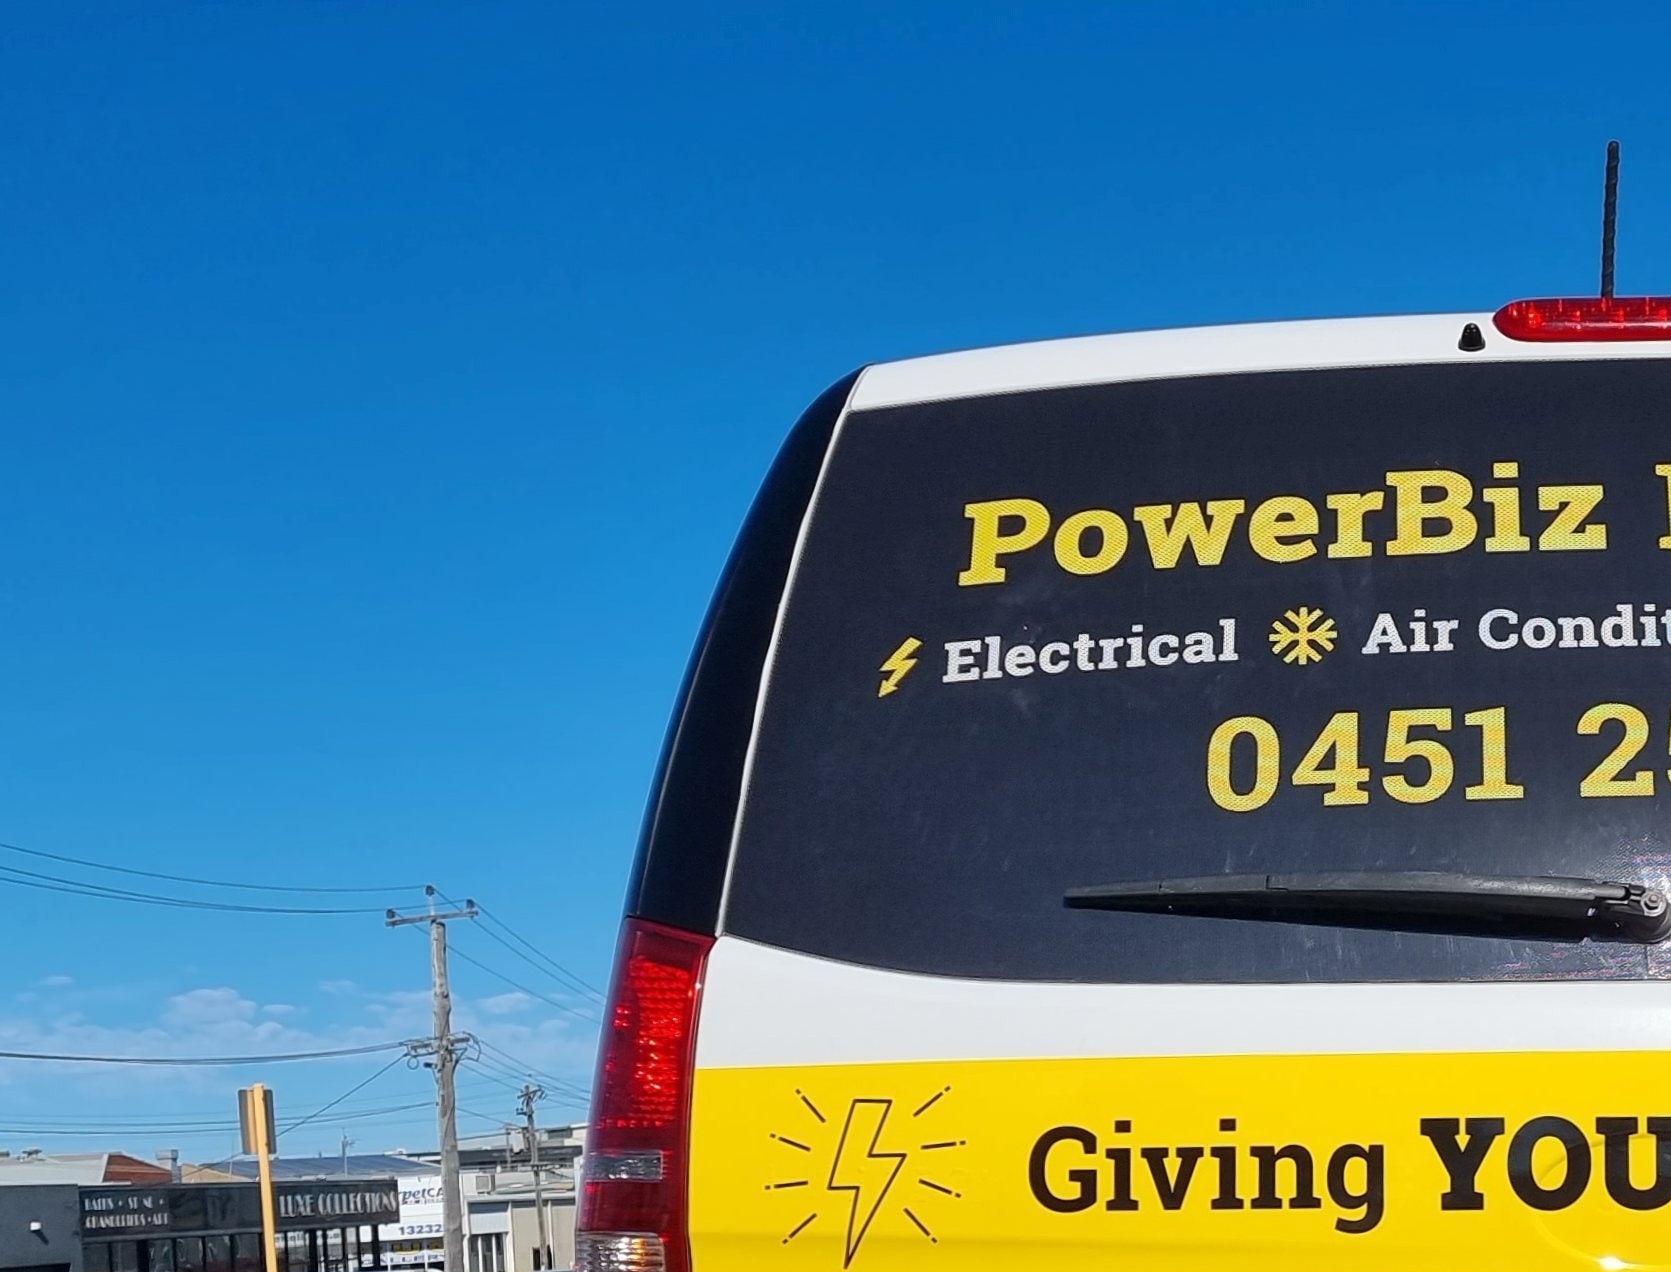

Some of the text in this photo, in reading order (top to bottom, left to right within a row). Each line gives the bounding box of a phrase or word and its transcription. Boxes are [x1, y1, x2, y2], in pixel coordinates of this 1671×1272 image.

[957, 461, 1608, 587] PowerBiz
[941, 619, 1239, 684] Electrical
[1361, 609, 1459, 656] Air
[1206, 703, 1525, 813] 0451
[279, 1189, 397, 1218] LUXE COLLECTIONS
[1027, 1118, 1385, 1234] Giving
